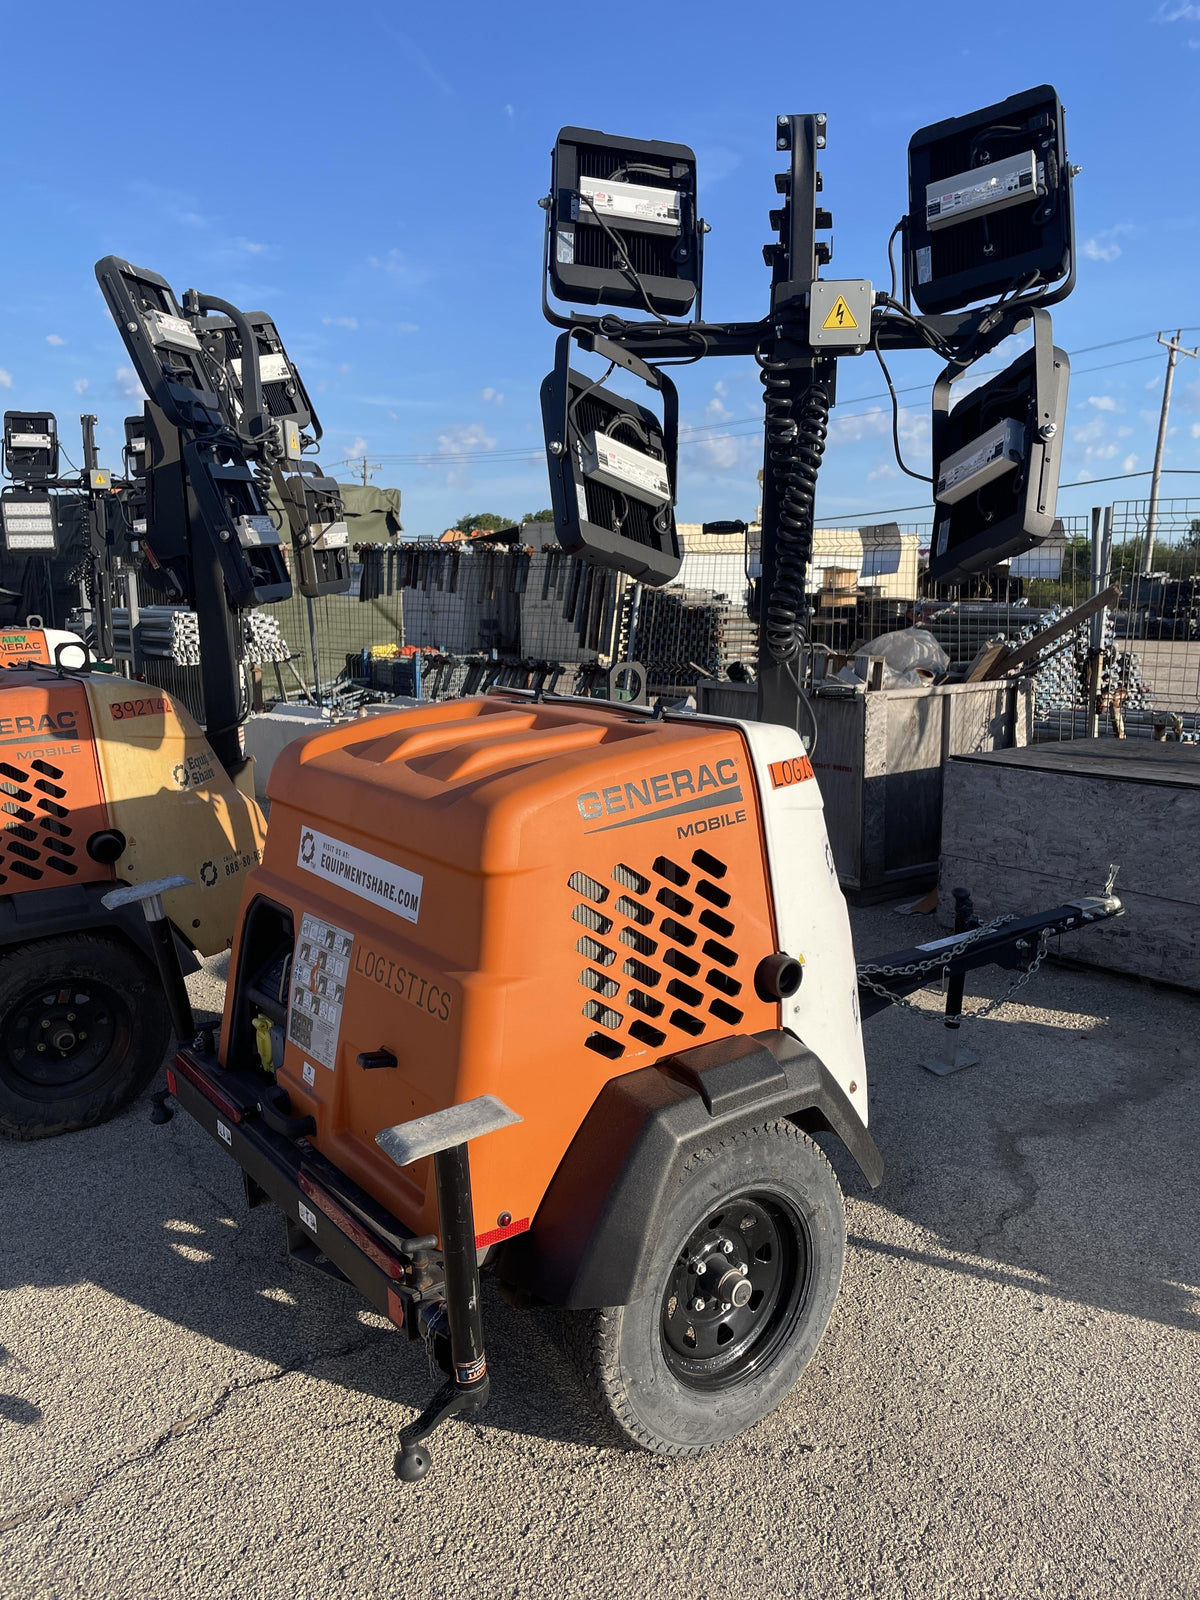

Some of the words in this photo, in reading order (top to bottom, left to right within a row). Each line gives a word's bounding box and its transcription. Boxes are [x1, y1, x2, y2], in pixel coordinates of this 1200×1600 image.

[17, 744, 81, 760] MOBILE
[577, 758, 739, 820] GENERAC
[677, 809, 747, 839] MOBILE
[321, 853, 418, 912] EQUIPMENTSHARE.COM
[355, 945, 451, 1021] LOGISTICS
